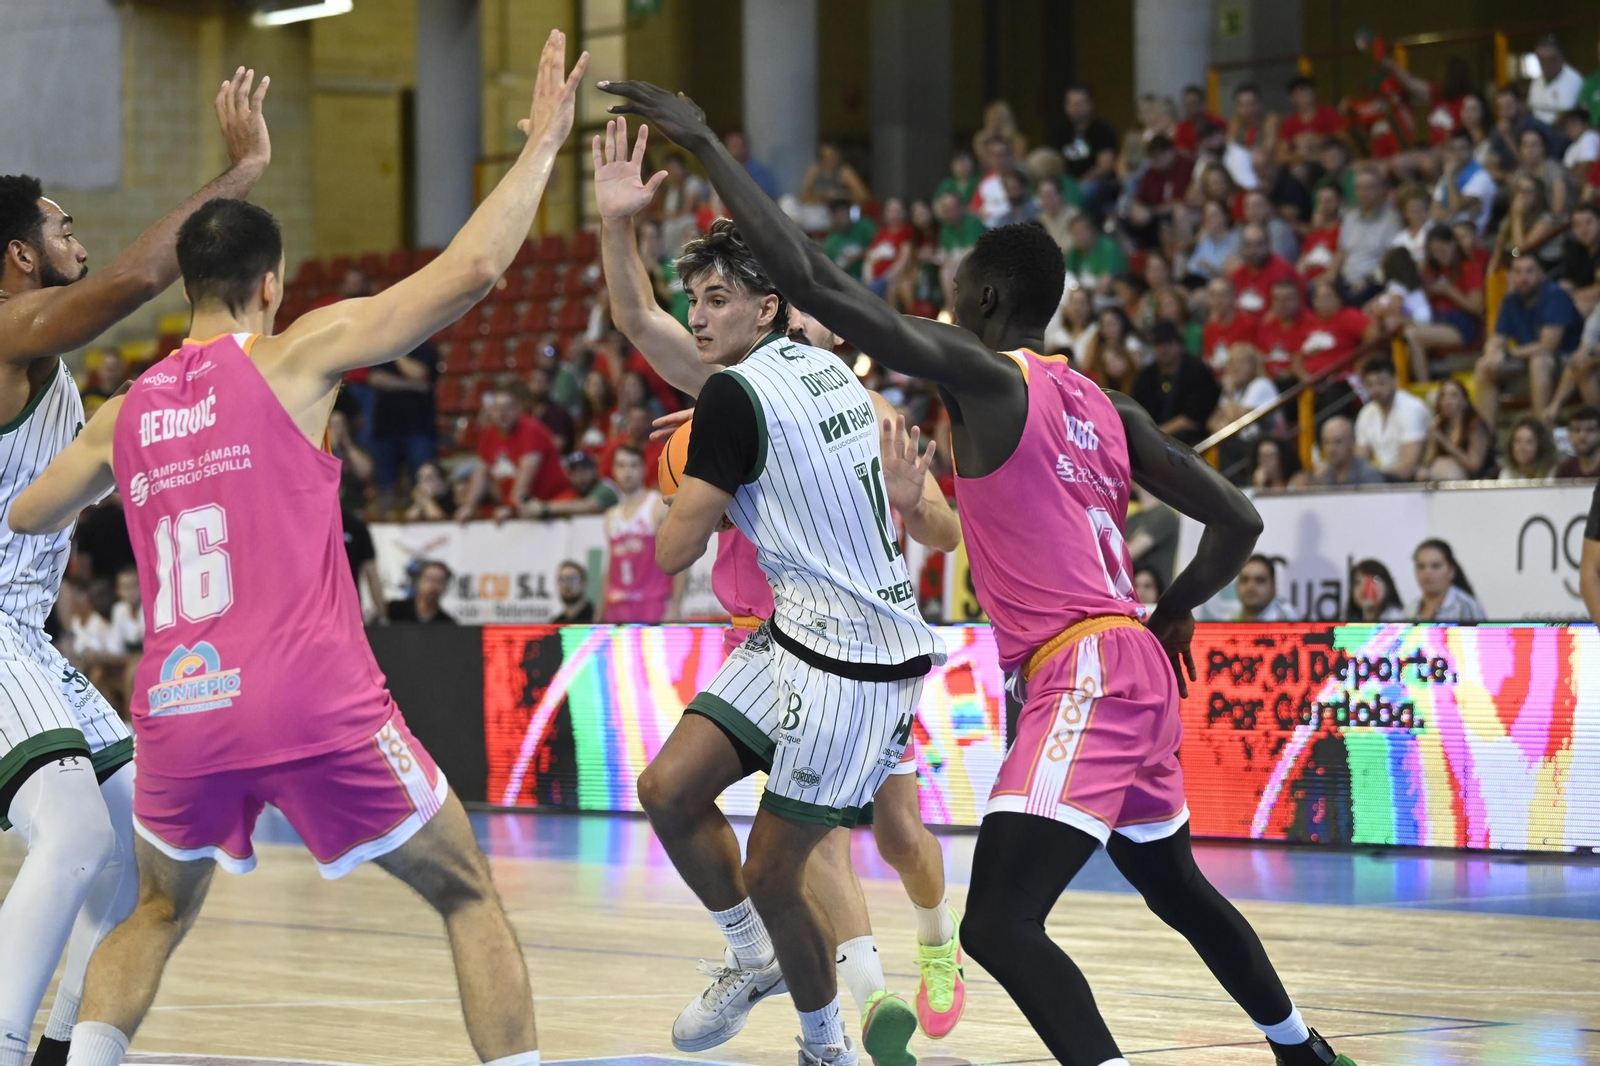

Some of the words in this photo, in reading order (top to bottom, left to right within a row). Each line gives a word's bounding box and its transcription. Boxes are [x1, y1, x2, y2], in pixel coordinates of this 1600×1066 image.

[800, 364, 849, 398] OROZCO
[148, 458, 195, 483] CAMPUS
[199, 444, 251, 467] CÁMARA
[150, 469, 203, 496] COMERCIO
[204, 457, 252, 478] SEVILLA
[153, 502, 234, 633] 16
[149, 674, 241, 710] MONTEPIO
